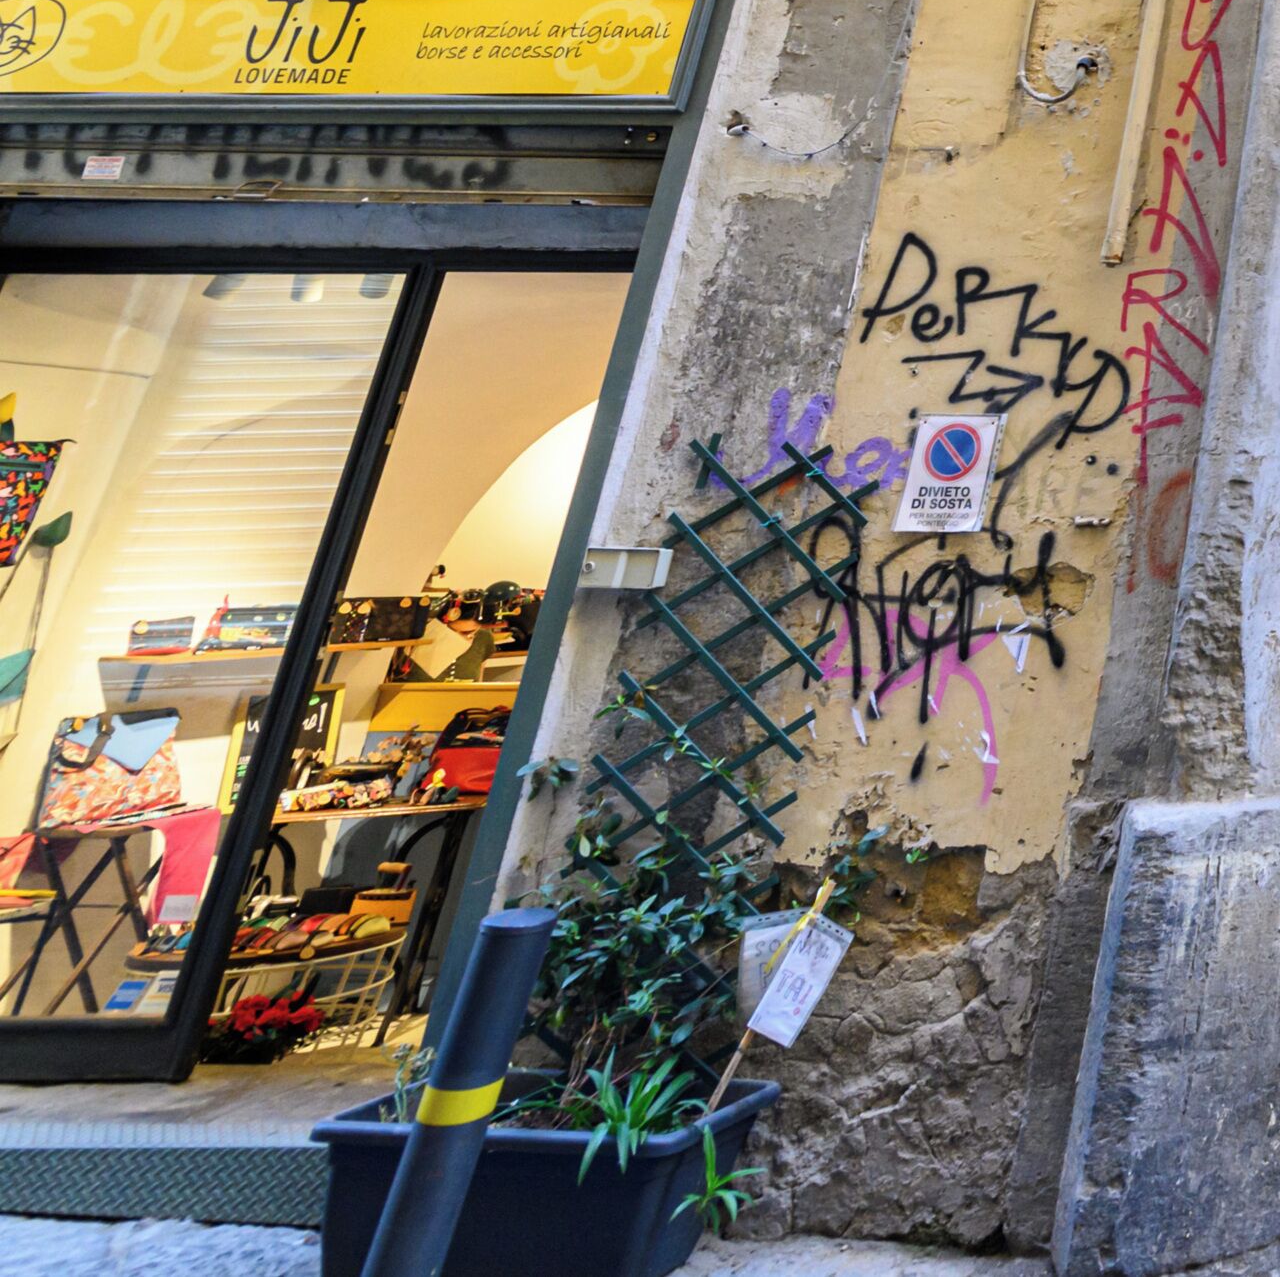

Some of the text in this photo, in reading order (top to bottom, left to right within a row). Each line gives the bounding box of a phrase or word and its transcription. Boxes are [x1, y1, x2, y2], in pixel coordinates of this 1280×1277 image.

[422, 21, 672, 44] lavorazioni artigianali
[416, 41, 583, 59] borse e accessori
[234, 68, 351, 84] LOVEMADE
[918, 486, 971, 498] DIVIETO
[911, 498, 972, 510] DI SOSTA
[925, 512, 969, 520] MONTAGGIO
